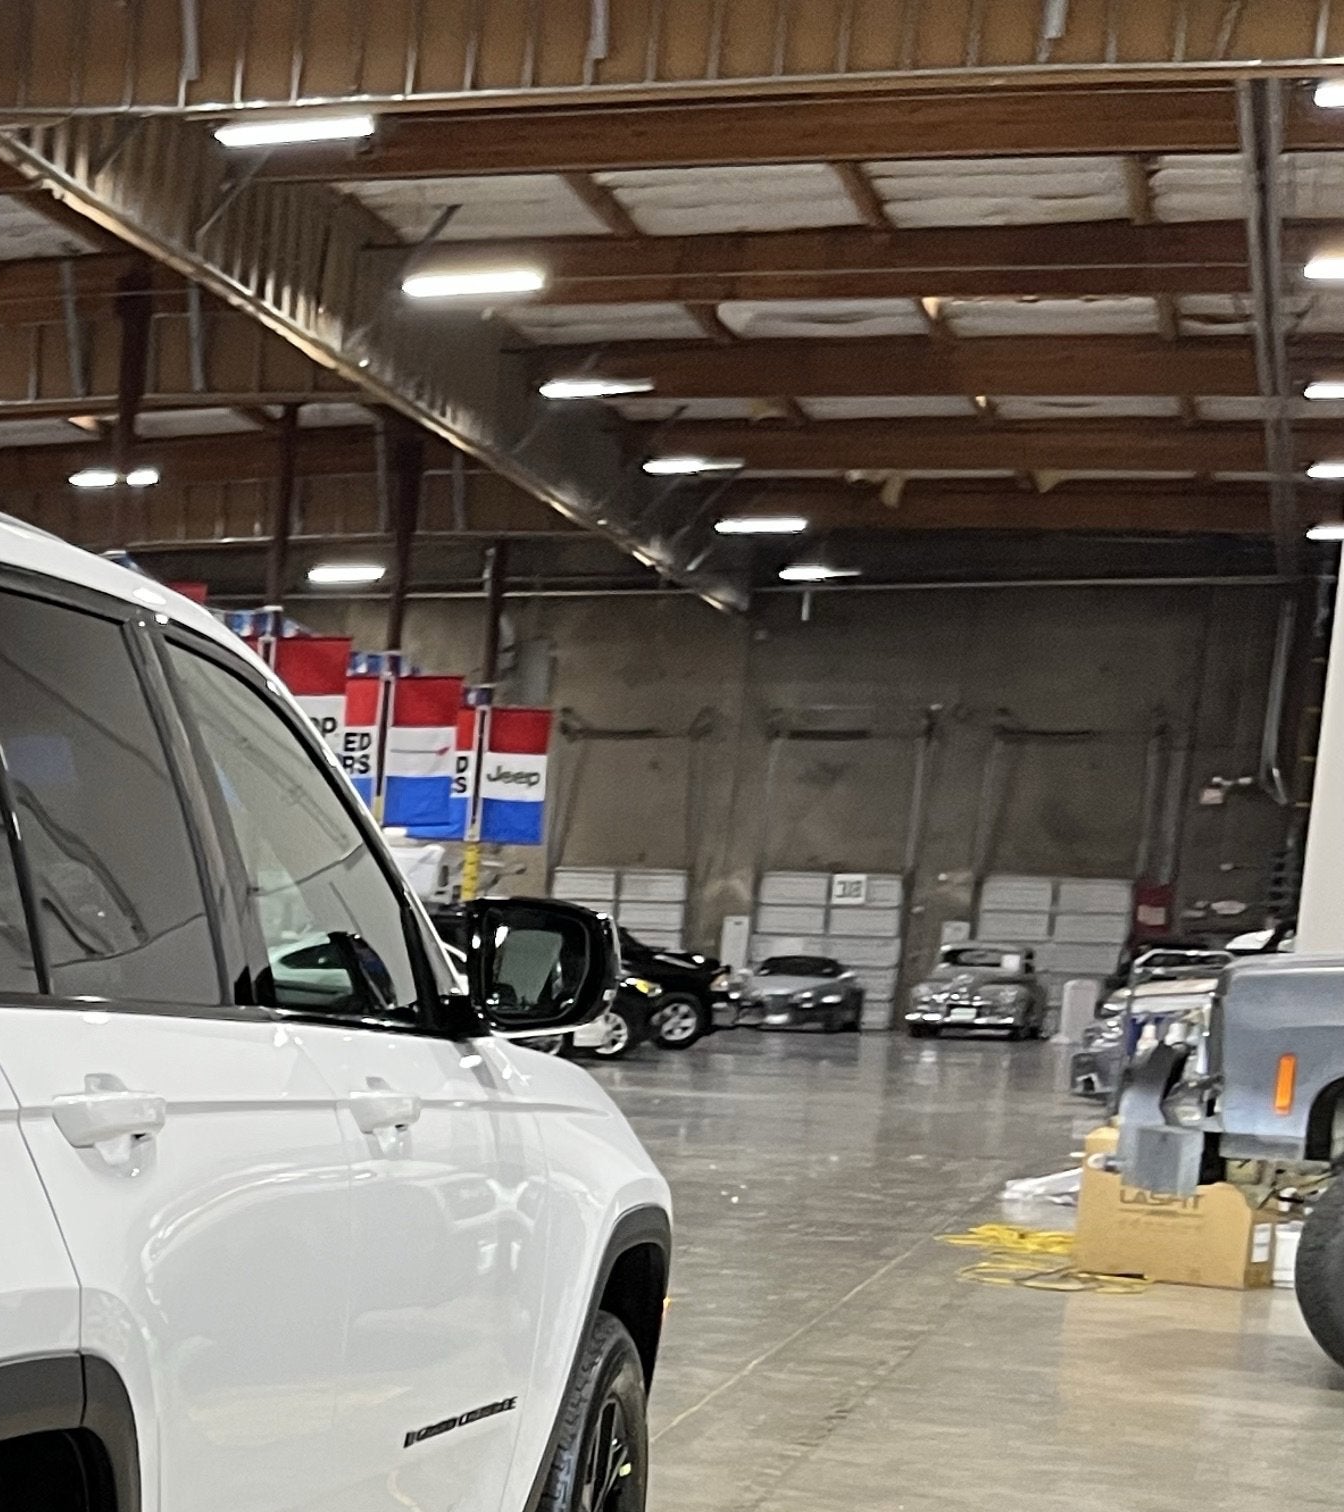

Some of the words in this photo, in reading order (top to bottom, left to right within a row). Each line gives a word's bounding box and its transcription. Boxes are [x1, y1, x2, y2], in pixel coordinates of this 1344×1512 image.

[343, 732, 372, 752] ED
[342, 754, 371, 775] RS
[486, 764, 541, 788] Jeep
